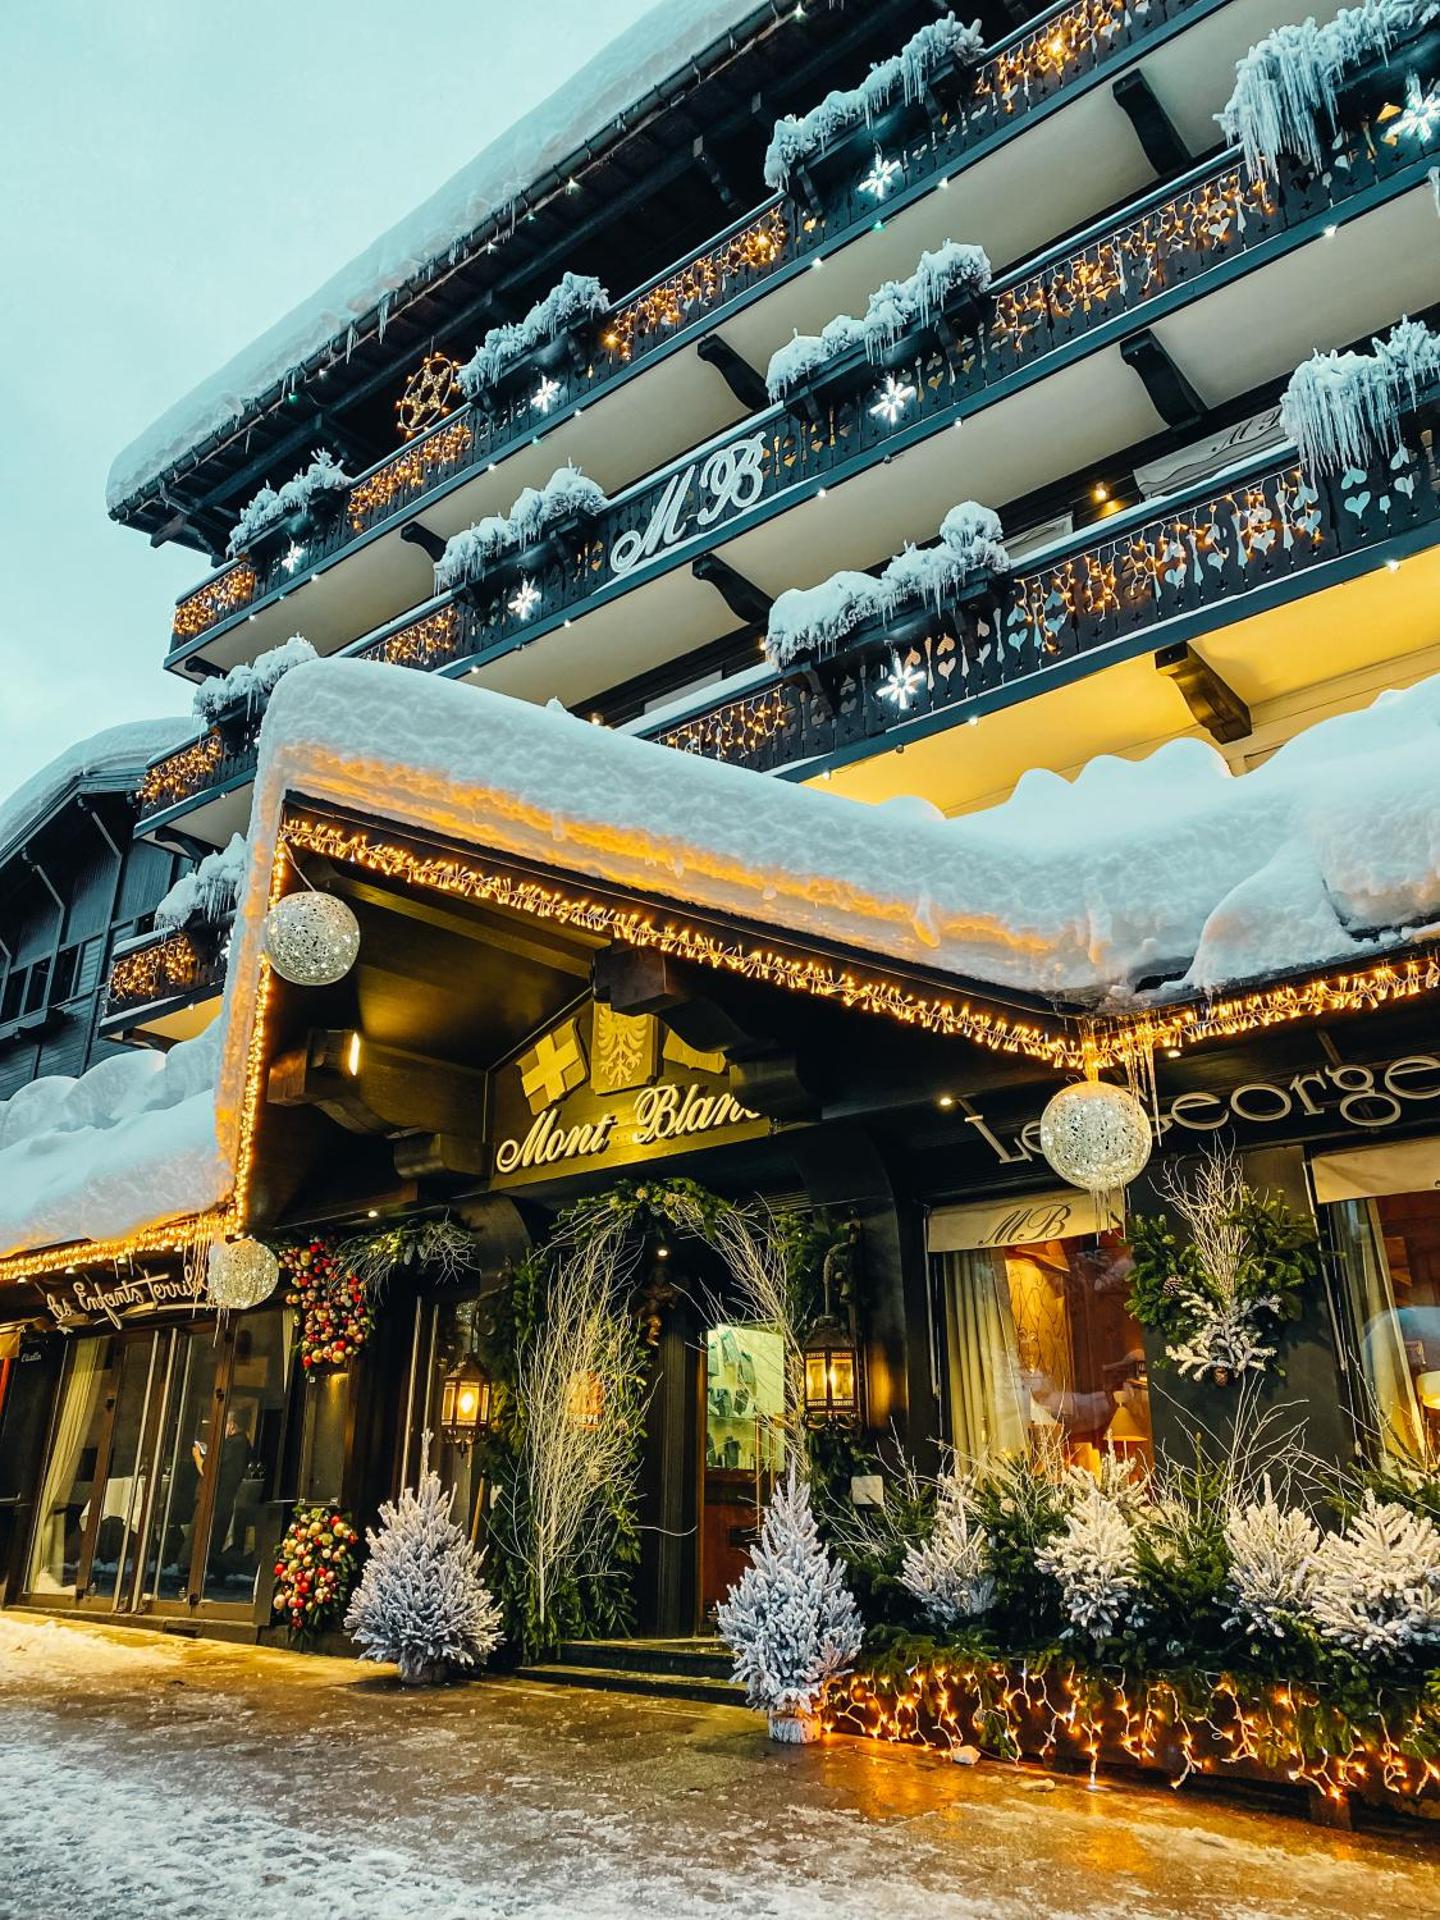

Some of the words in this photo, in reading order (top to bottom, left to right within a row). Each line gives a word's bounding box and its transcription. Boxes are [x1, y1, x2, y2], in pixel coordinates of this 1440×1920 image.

[1117, 1054, 1440, 1138] eorge
[496, 1107, 619, 1174] Mont
[977, 1202, 1073, 1246] MB
[134, 1264, 210, 1304] Terribl
